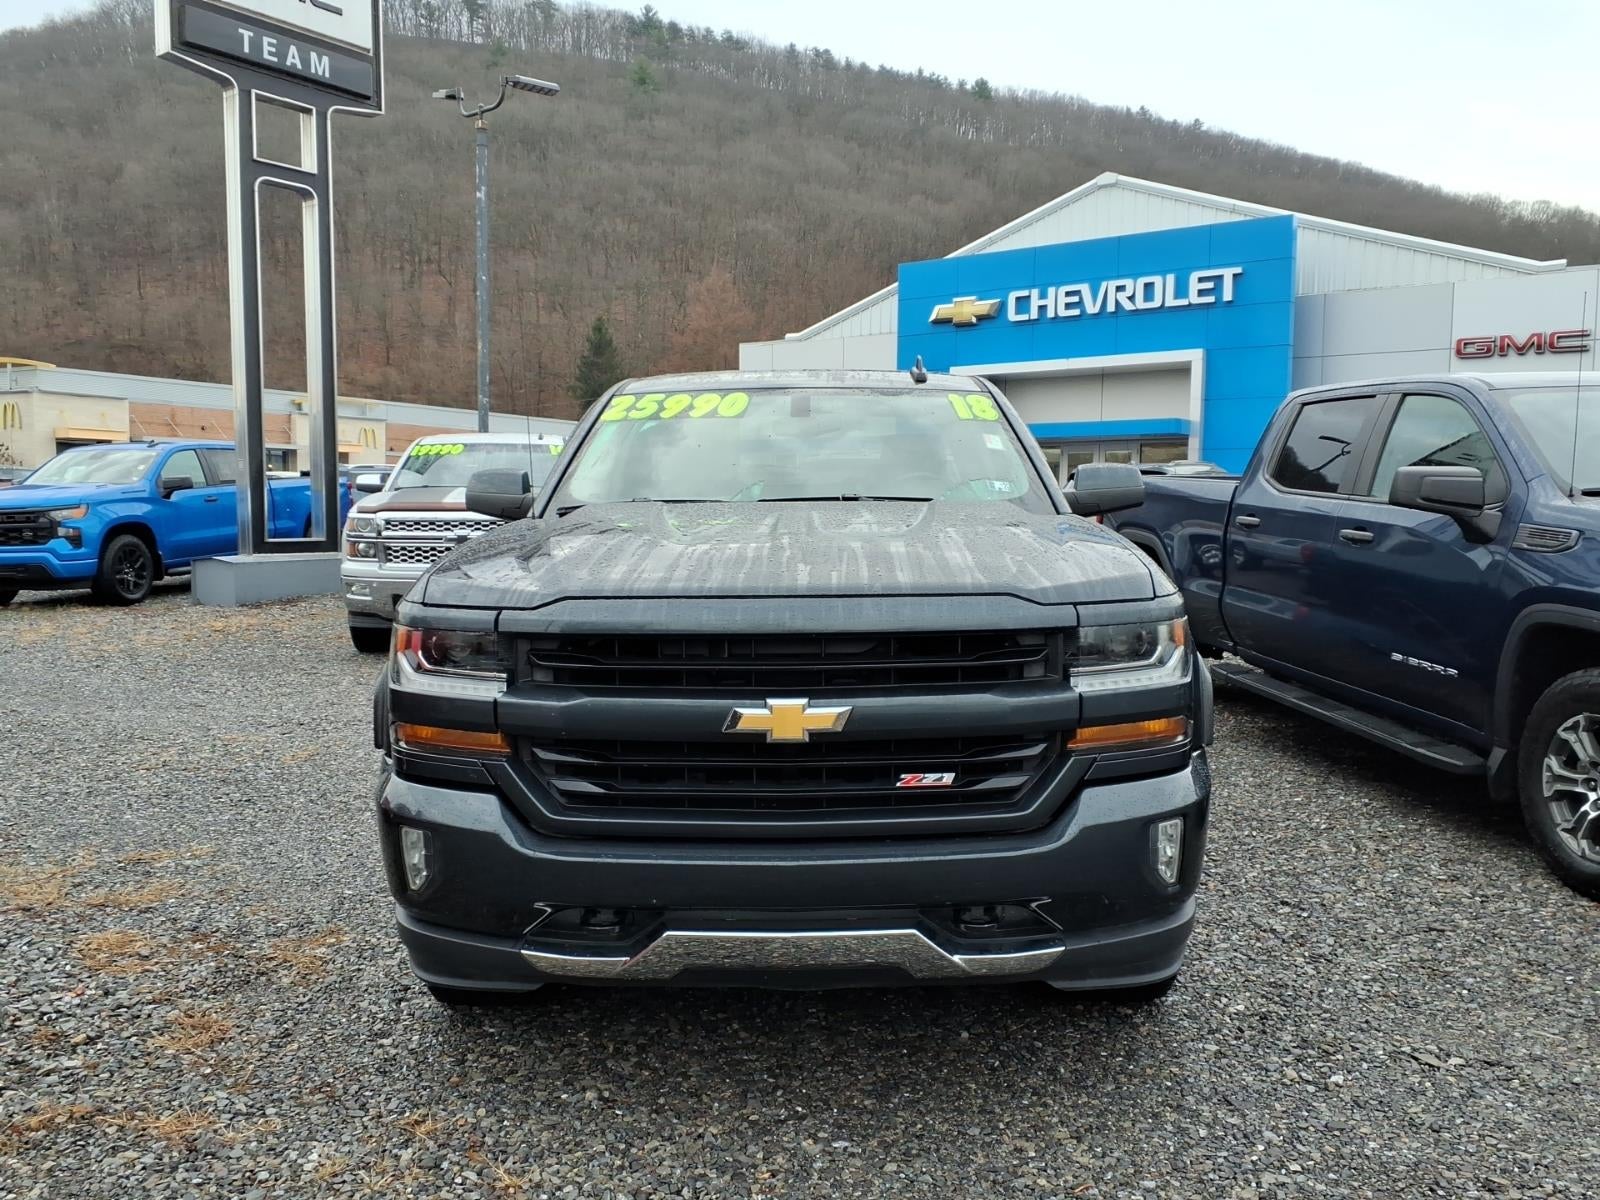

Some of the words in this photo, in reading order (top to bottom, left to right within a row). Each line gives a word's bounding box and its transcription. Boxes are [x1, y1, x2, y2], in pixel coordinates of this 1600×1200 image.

[238, 28, 330, 78] TEAM
[1007, 266, 1243, 322] CHEVROLET
[1455, 329, 1591, 359] GMC
[600, 391, 750, 421] 25990
[947, 393, 1000, 421] 18
[410, 443, 465, 456] 19990
[895, 772, 956, 787] Z71
